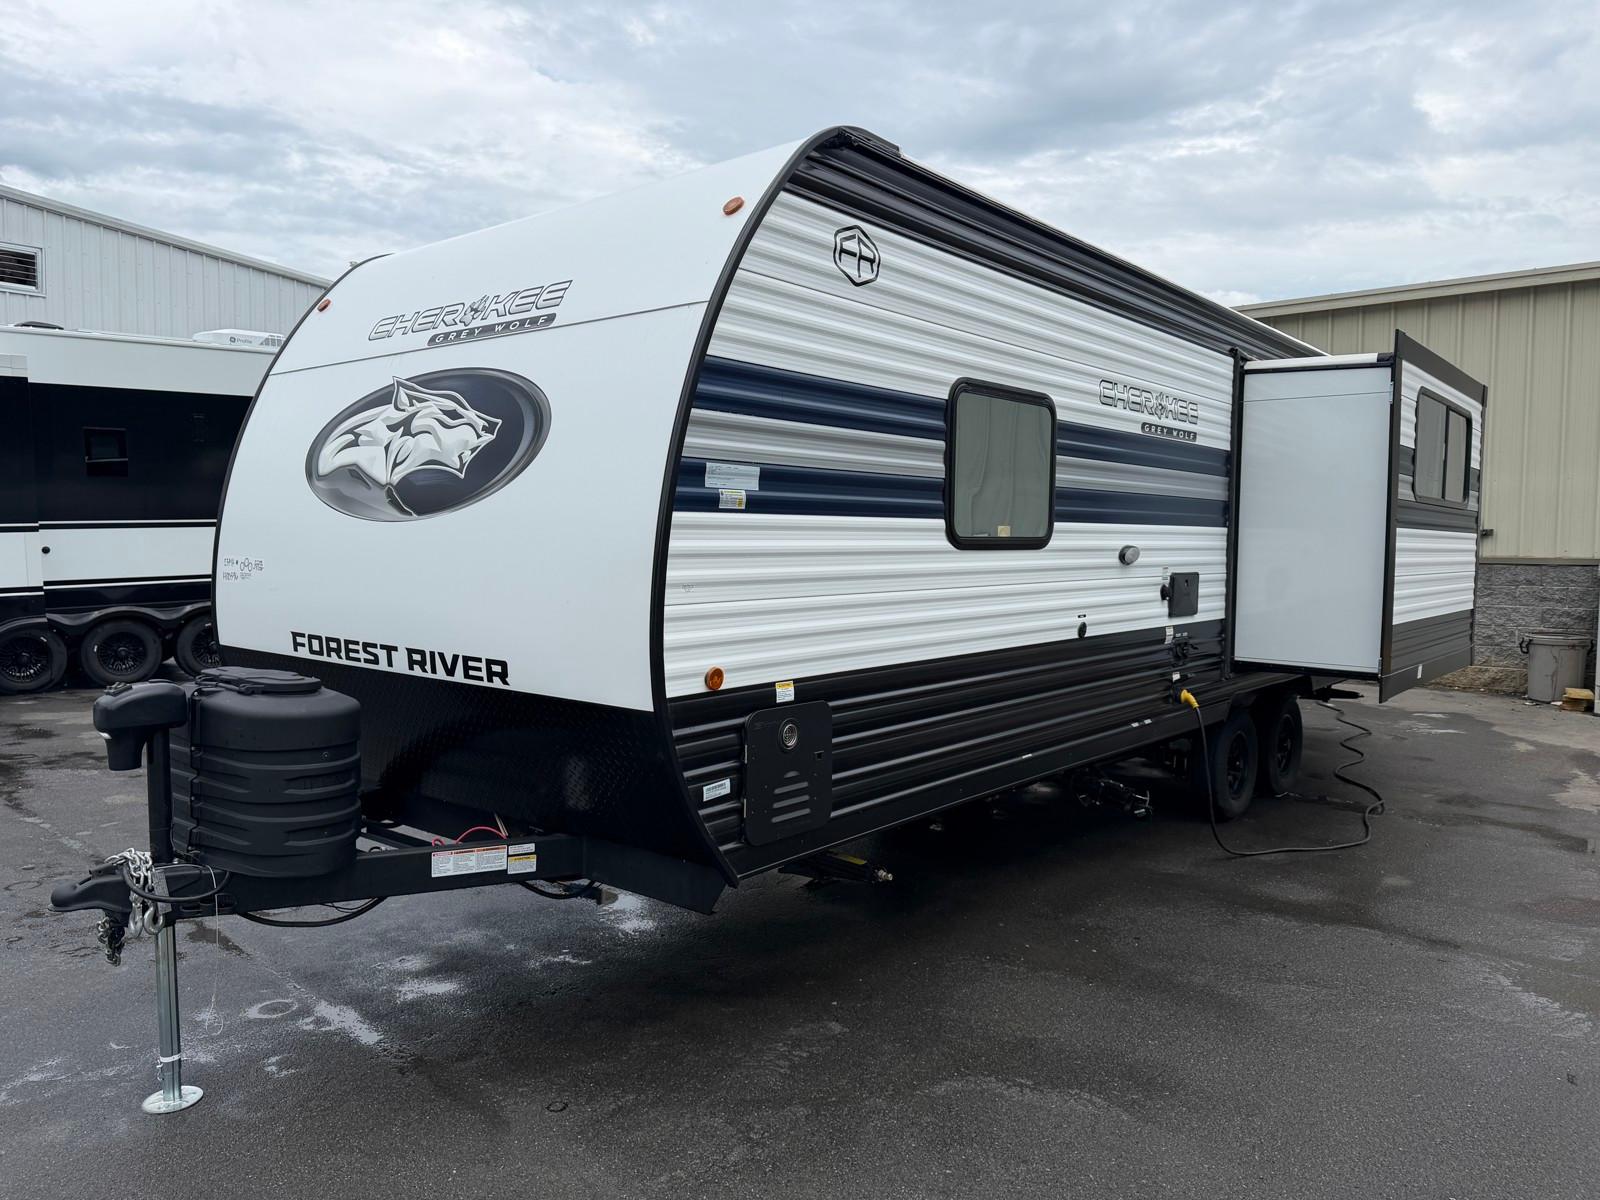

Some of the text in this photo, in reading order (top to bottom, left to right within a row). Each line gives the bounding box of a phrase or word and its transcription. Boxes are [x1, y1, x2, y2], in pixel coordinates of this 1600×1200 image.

[435, 315, 549, 343] GREY WOLF
[1144, 424, 1196, 440] GREY WOLF
[290, 631, 511, 686] FOREST RIVER
